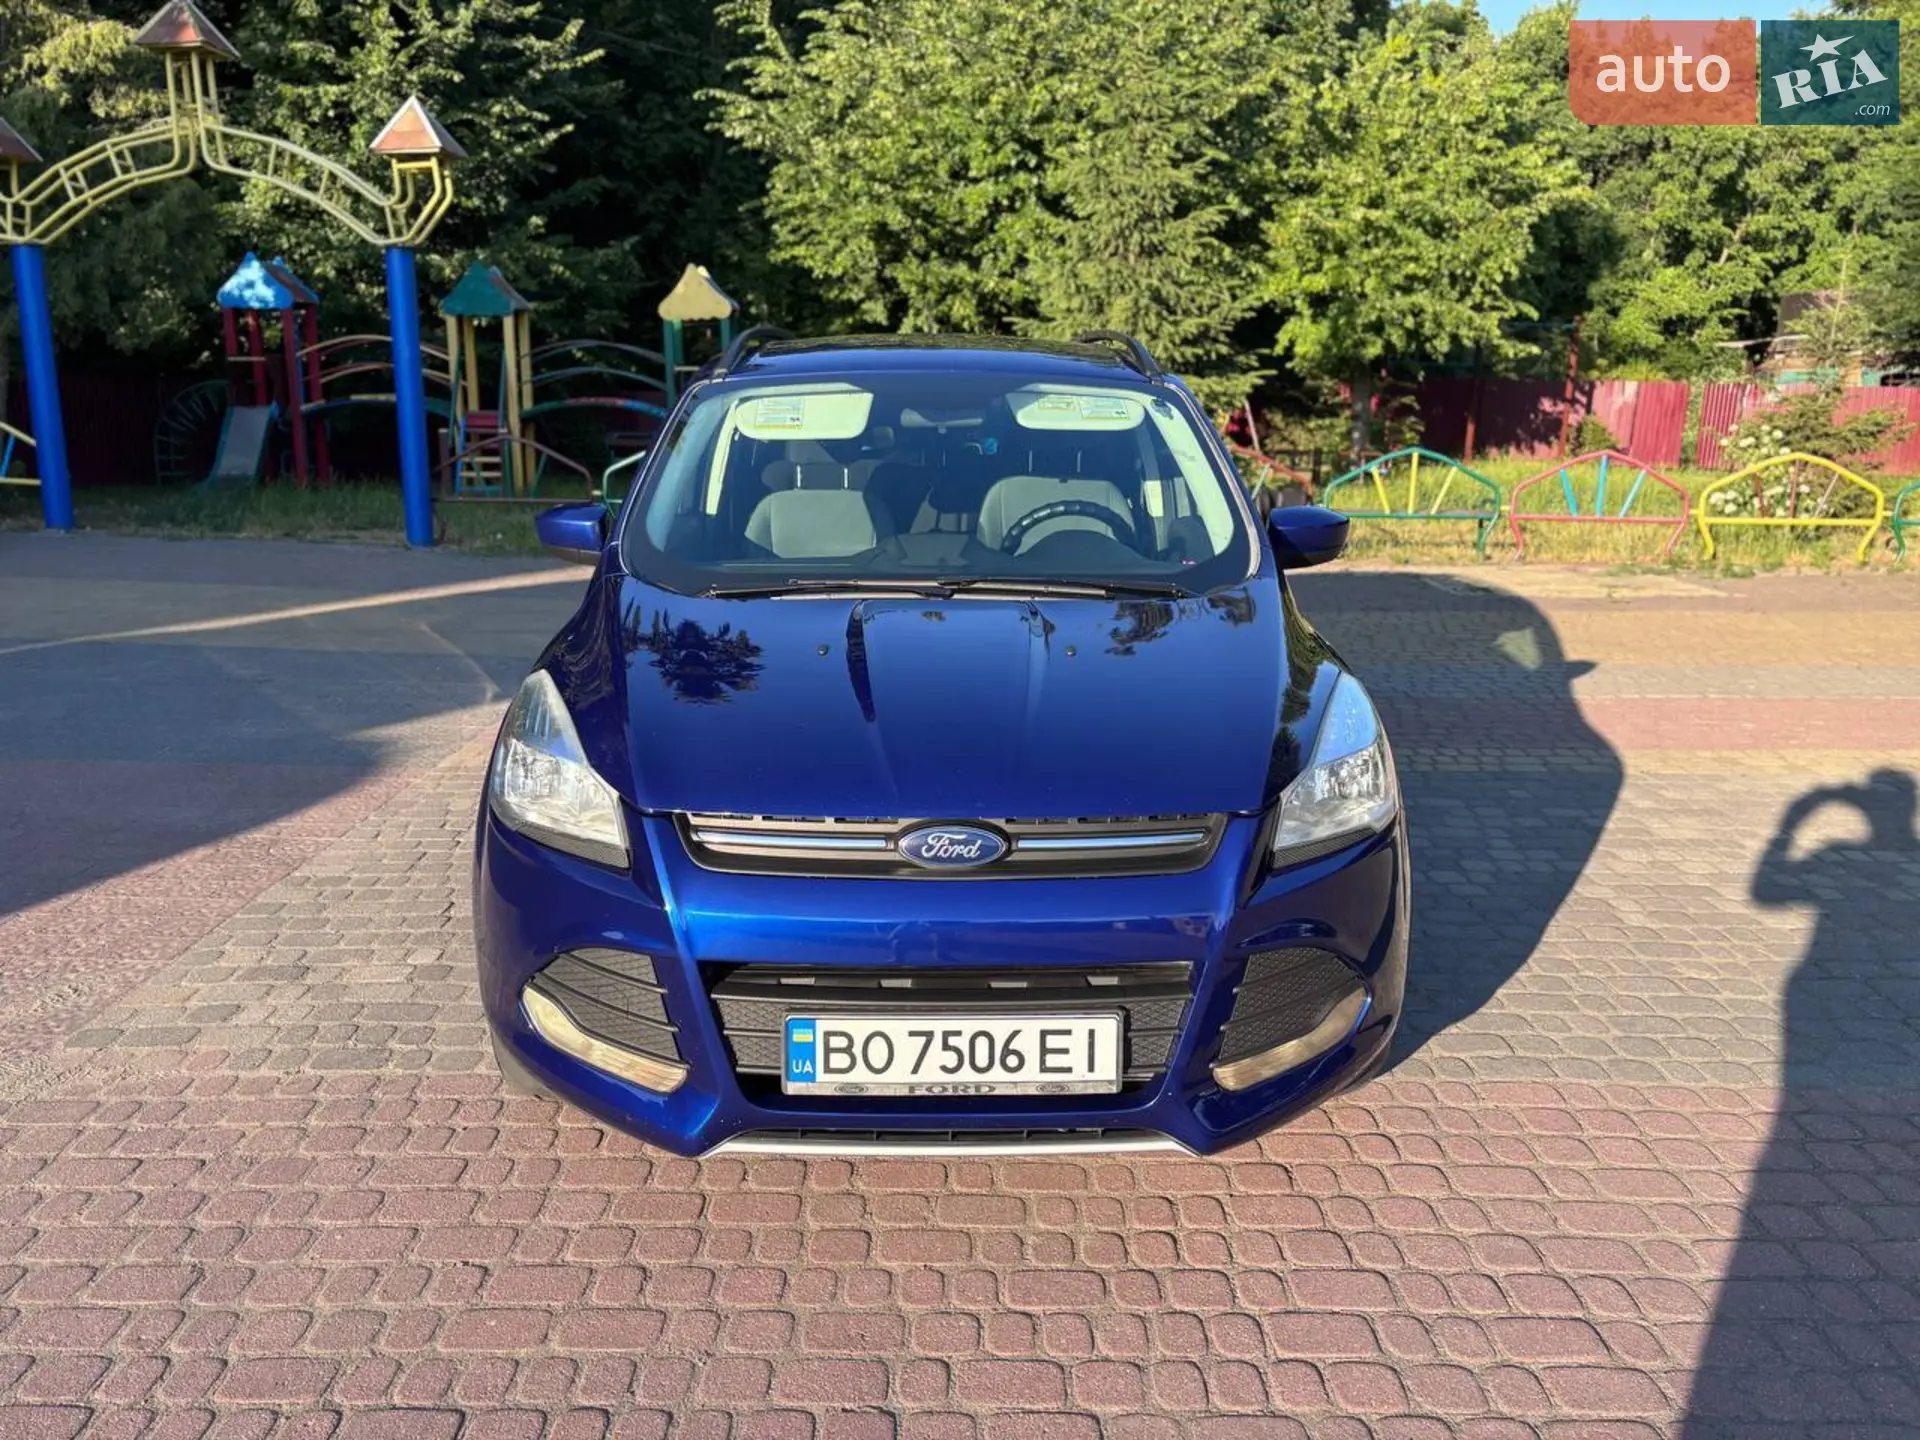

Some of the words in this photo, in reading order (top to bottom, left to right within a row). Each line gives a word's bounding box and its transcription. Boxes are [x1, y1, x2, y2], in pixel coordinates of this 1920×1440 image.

[921, 832, 982, 858] Ford
[823, 1030, 895, 1075] BO
[907, 1028, 1025, 1075] 7506
[792, 1059, 814, 1074] UA
[908, 1084, 996, 1094] FORD
